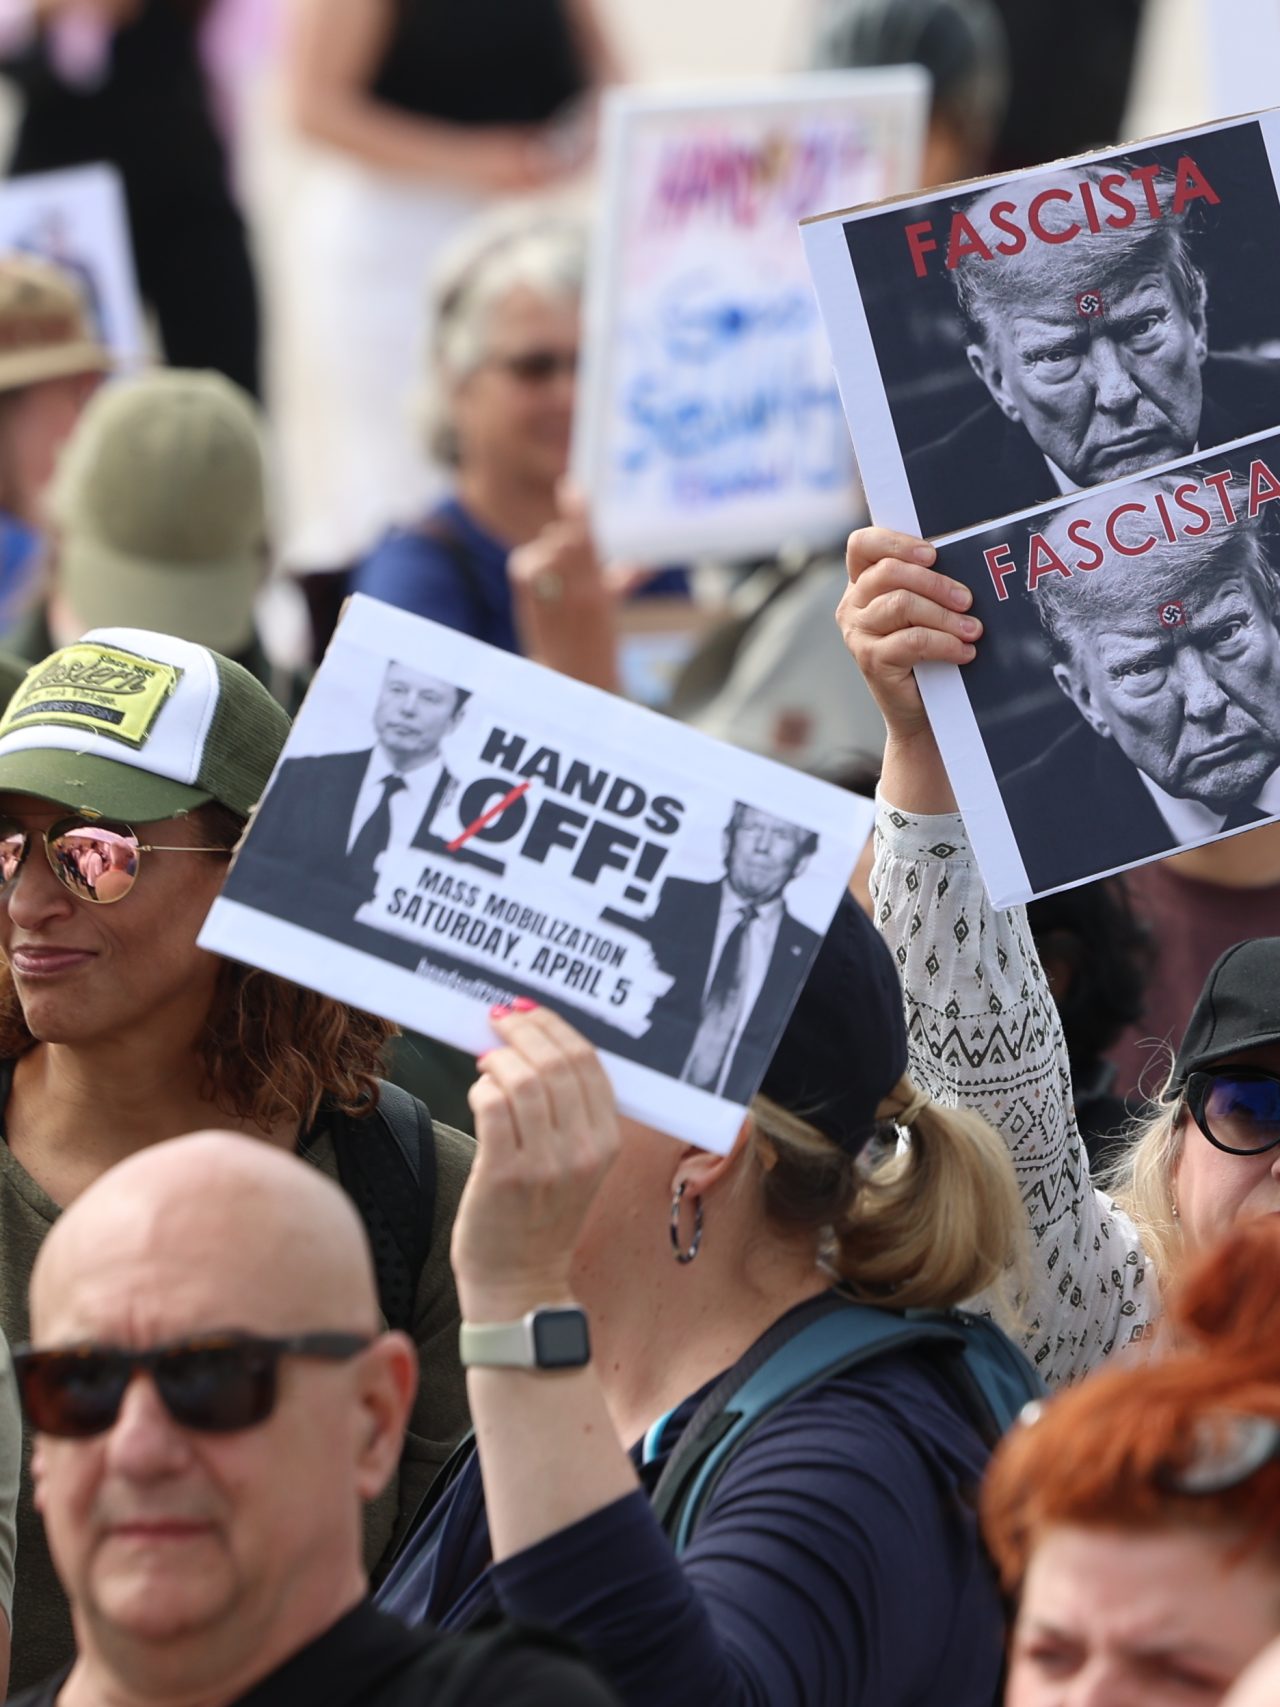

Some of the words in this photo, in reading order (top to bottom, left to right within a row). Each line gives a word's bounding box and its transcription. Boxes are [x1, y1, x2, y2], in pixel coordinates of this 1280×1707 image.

[905, 155, 1221, 278] FASCISTA
[479, 727, 686, 835] HANDS
[458, 777, 670, 905] OFF!
[418, 866, 481, 908] MASS
[483, 892, 628, 969] MOBILIZATION
[530, 947, 599, 997] APRIL
[610, 978, 633, 1007] 5
